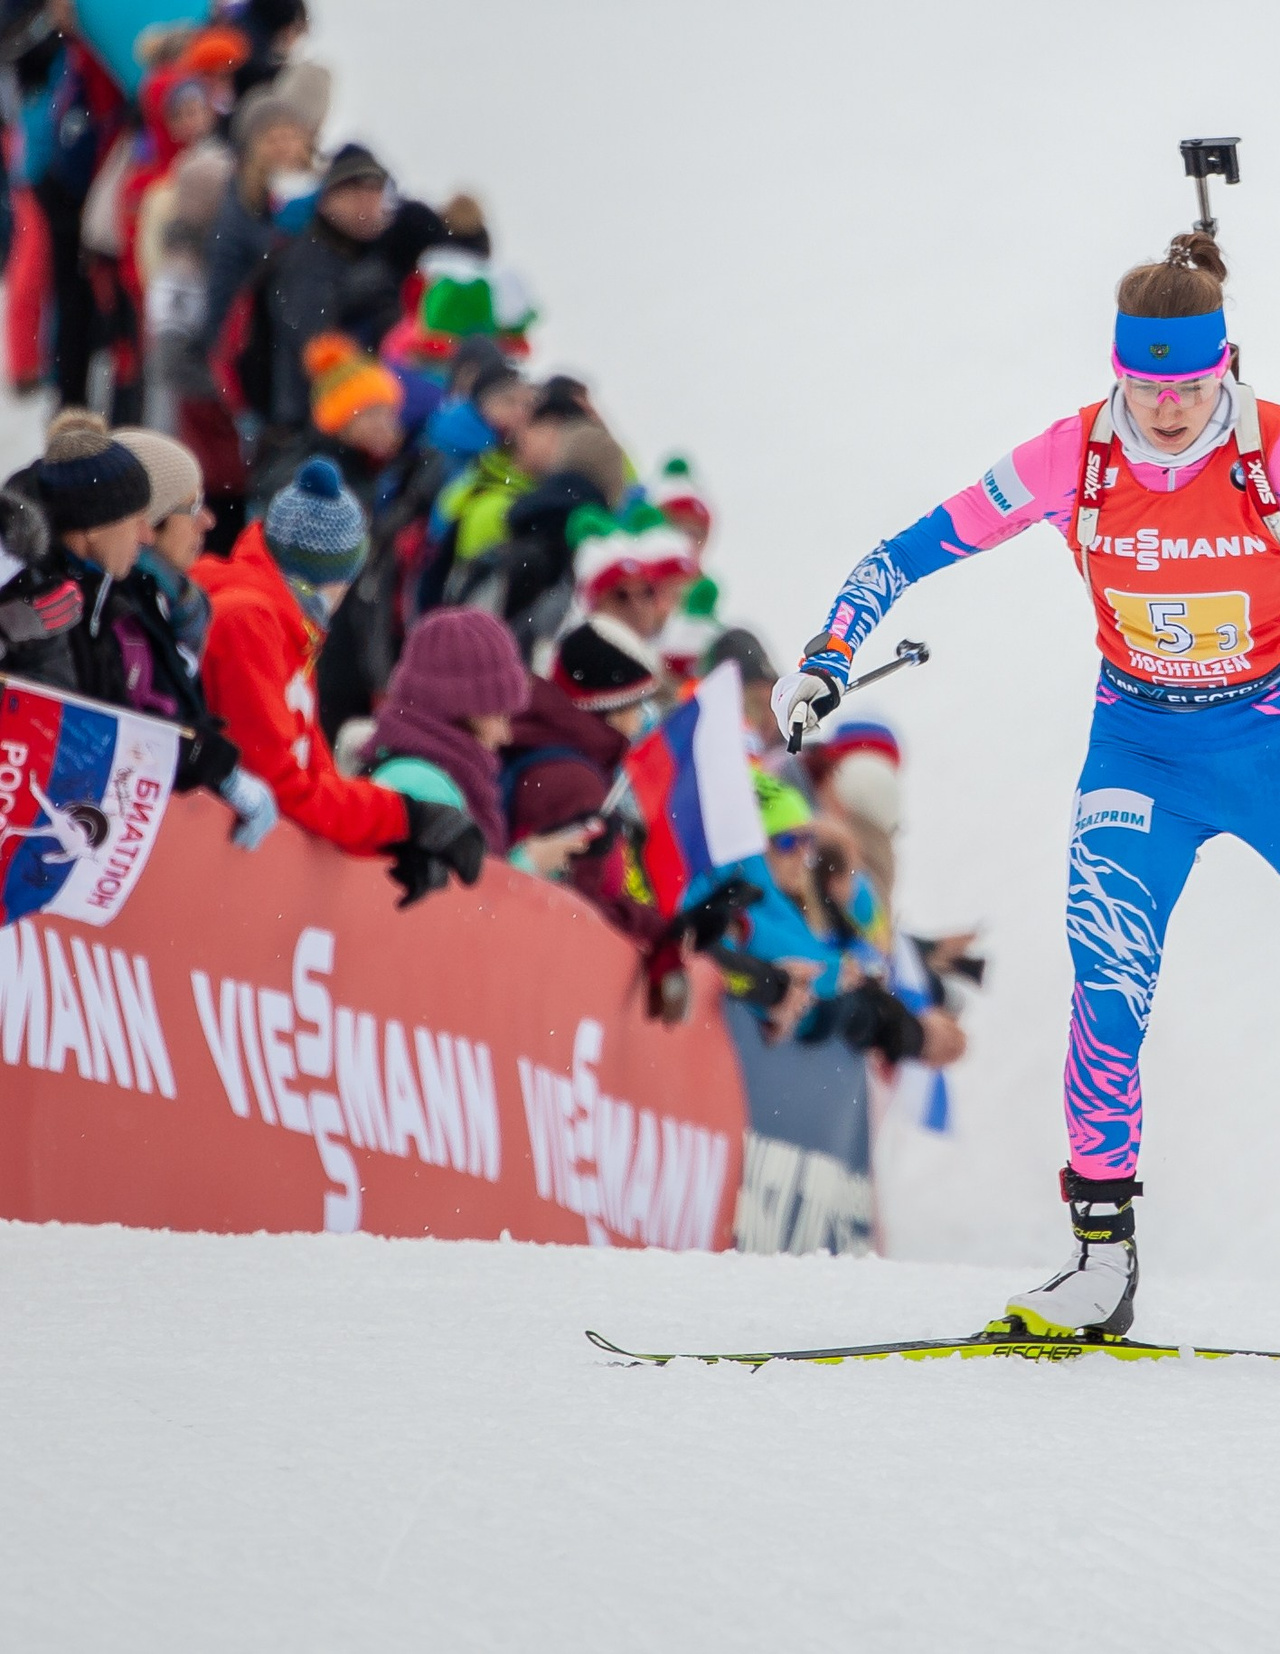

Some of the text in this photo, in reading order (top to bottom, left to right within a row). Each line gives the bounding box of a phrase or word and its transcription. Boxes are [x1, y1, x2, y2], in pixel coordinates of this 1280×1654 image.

[1147, 602, 1194, 655] 5
[1128, 650, 1252, 678] HOCHFILZEN
[86, 777, 162, 908] БИАТЛОН
[190, 926, 501, 1233] VIESSMANN
[993, 1345, 1083, 1361] FISCHER
